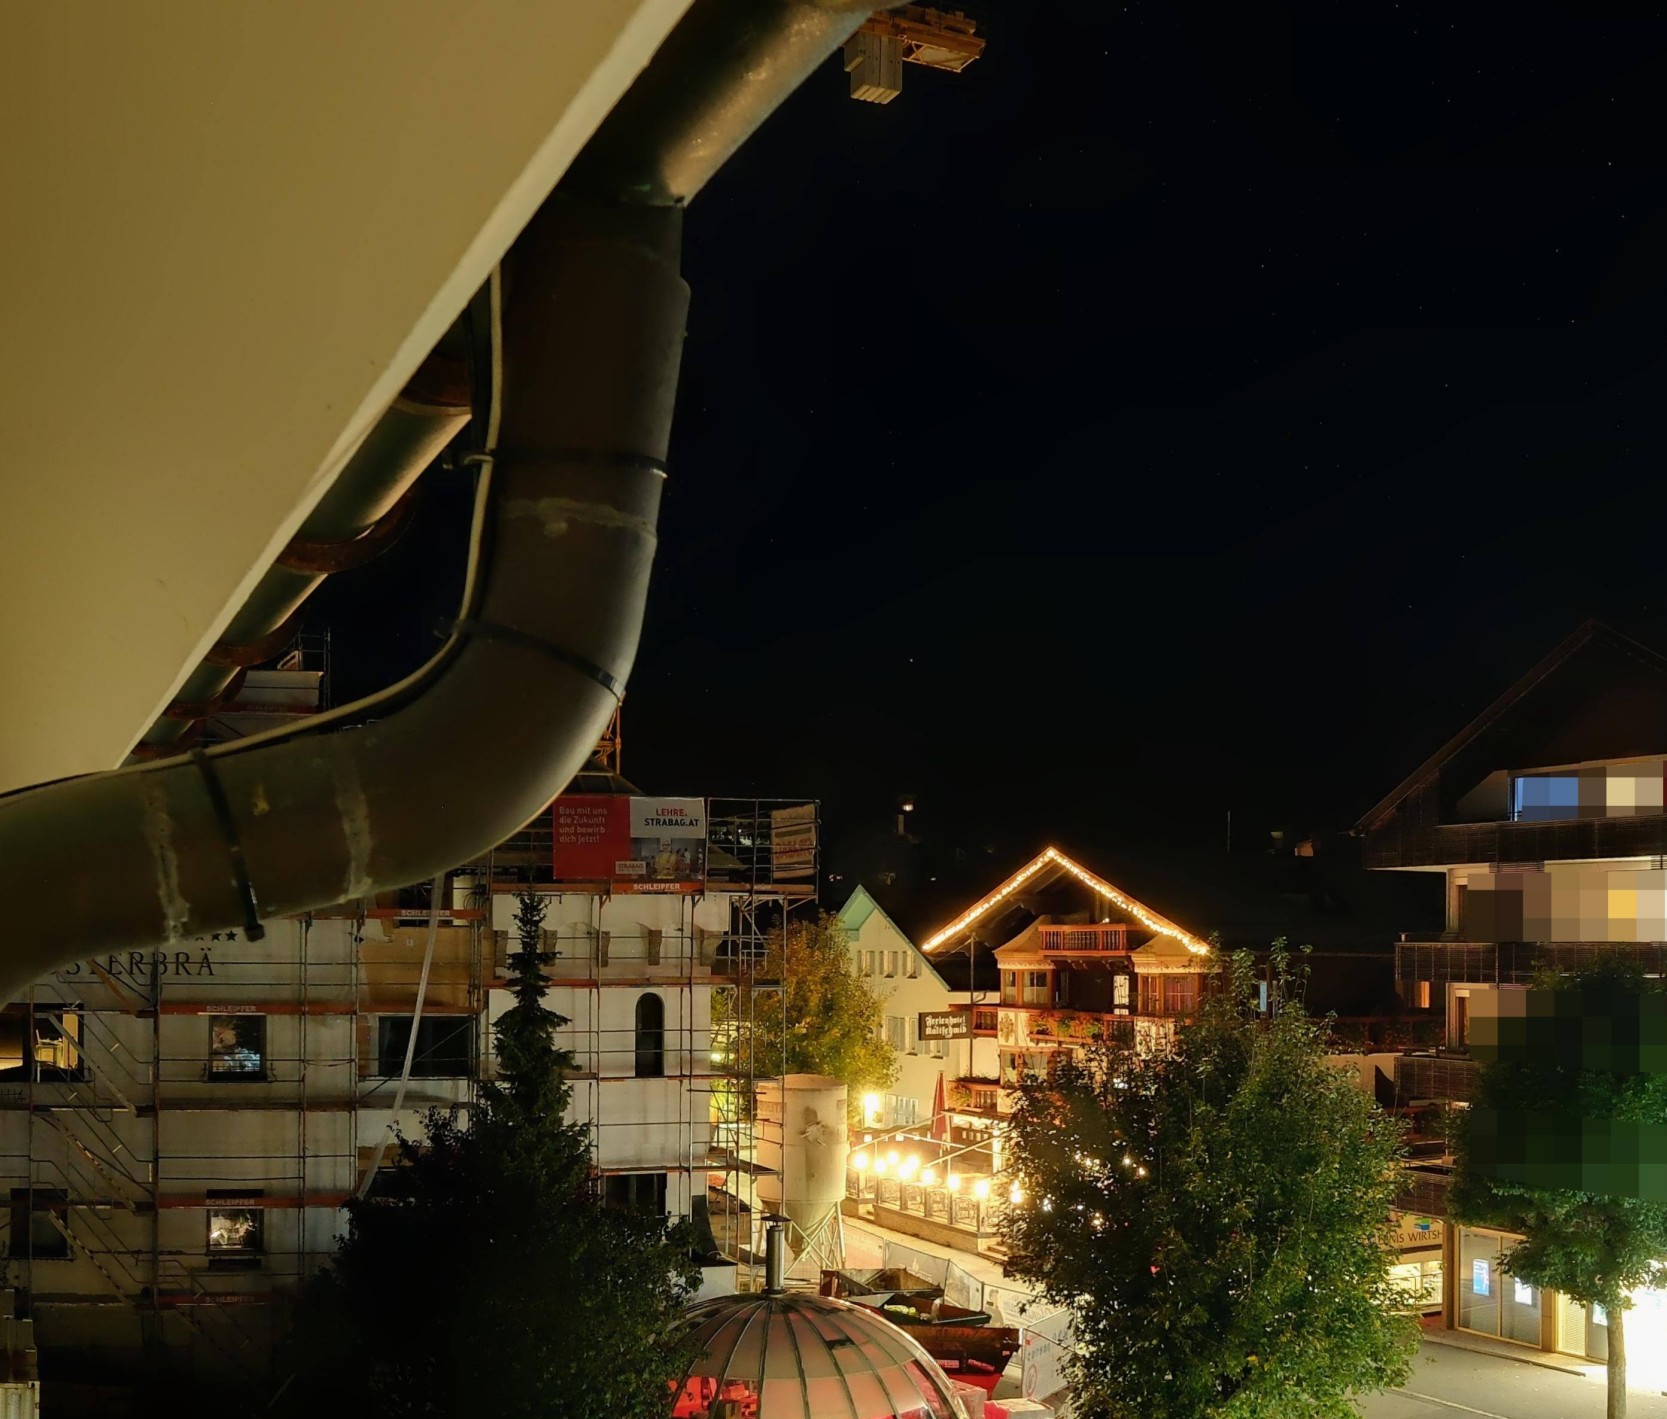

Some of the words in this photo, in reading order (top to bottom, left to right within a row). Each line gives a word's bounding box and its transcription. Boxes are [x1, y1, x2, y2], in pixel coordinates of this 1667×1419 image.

[559, 807, 578, 815] Bau
[578, 807, 590, 816] mit
[656, 808, 687, 817] LEHRE.
[559, 816, 572, 824] die
[574, 816, 606, 824] Zukunft
[644, 818, 699, 828] STRABAG.AT
[559, 825, 573, 834] und
[576, 825, 606, 834] bewirb
[559, 834, 576, 843] dich
[577, 834, 600, 844] jetzt!
[206, 1004, 256, 1012] SCHLEIPFER
